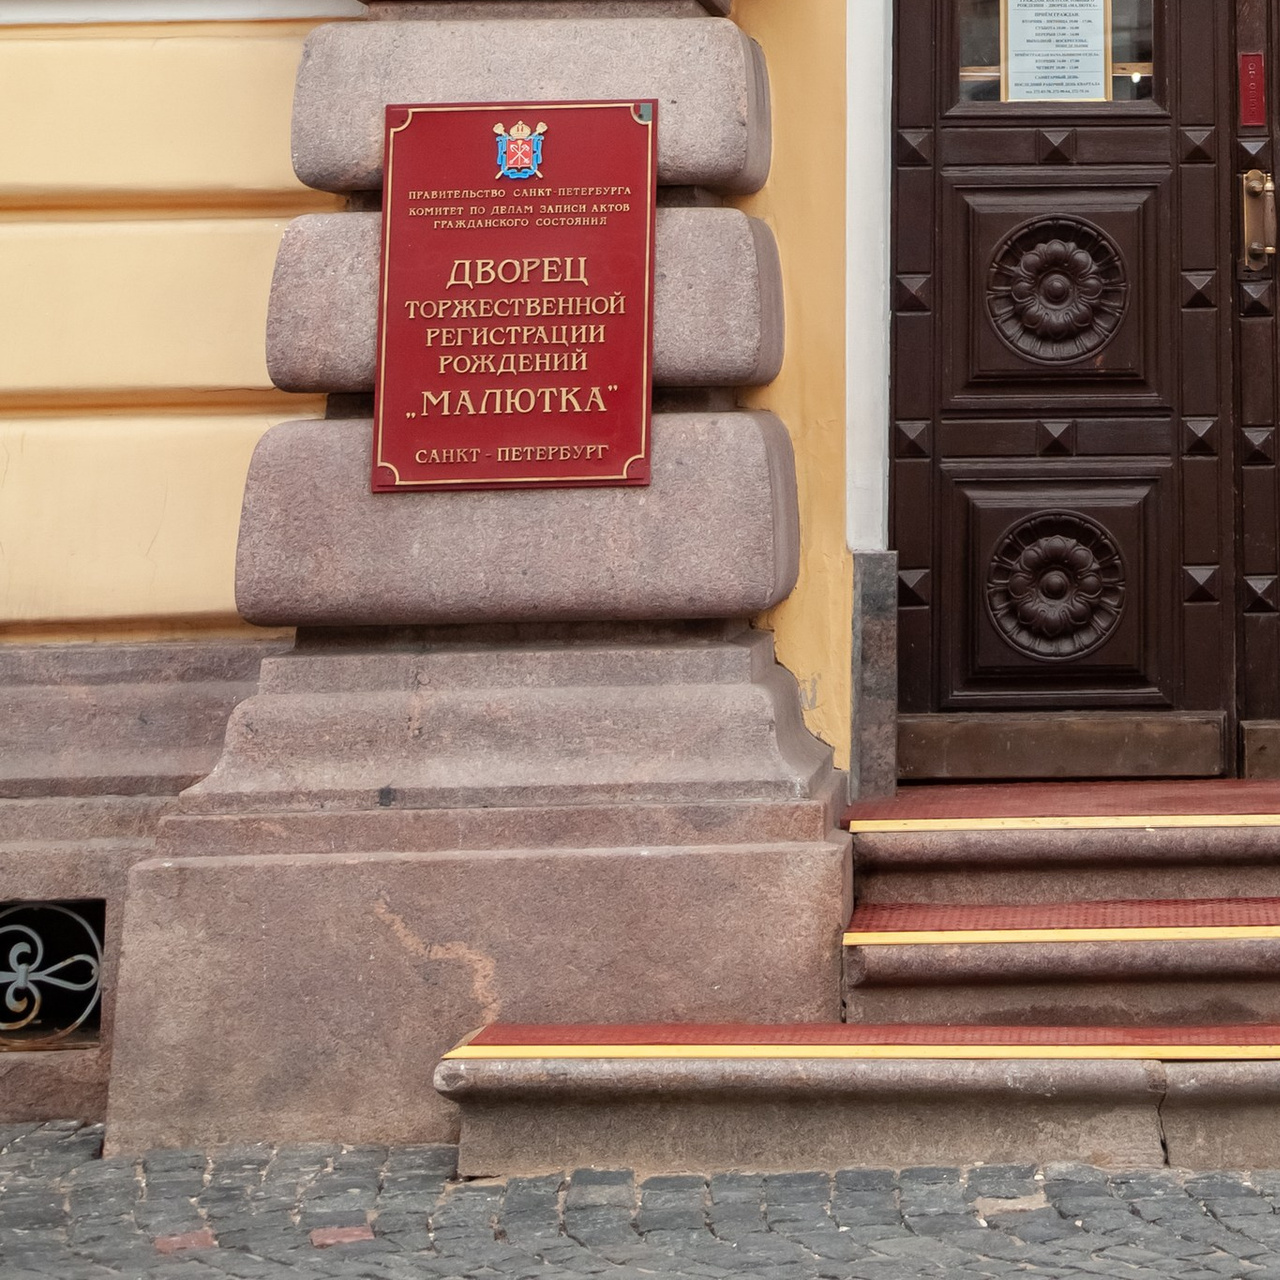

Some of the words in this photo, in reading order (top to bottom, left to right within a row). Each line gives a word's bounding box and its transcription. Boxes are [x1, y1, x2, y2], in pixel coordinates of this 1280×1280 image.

[409, 189, 505, 199] ПРАВИТЕЛЬСТВО
[514, 187, 631, 196] САНКТ-ПЕТЕРБУРГА
[409, 207, 463, 215] КОМИТЕТ
[491, 206, 533, 215] ДЕЛАМ
[540, 205, 586, 213] ЗАПИСИ
[592, 204, 629, 212] АКТОВ
[434, 219, 529, 229] ГРАЖДАНСКОГО
[536, 217, 606, 226] СОСТОЯНИЯ
[446, 257, 588, 289] ДВОРЕЦ
[405, 292, 625, 318] ТОРЖЕСТВЕННОЙ
[426, 325, 605, 349] РЕГИСТРАЦИИ
[439, 348, 587, 375] РОЖДЕНИЙ
